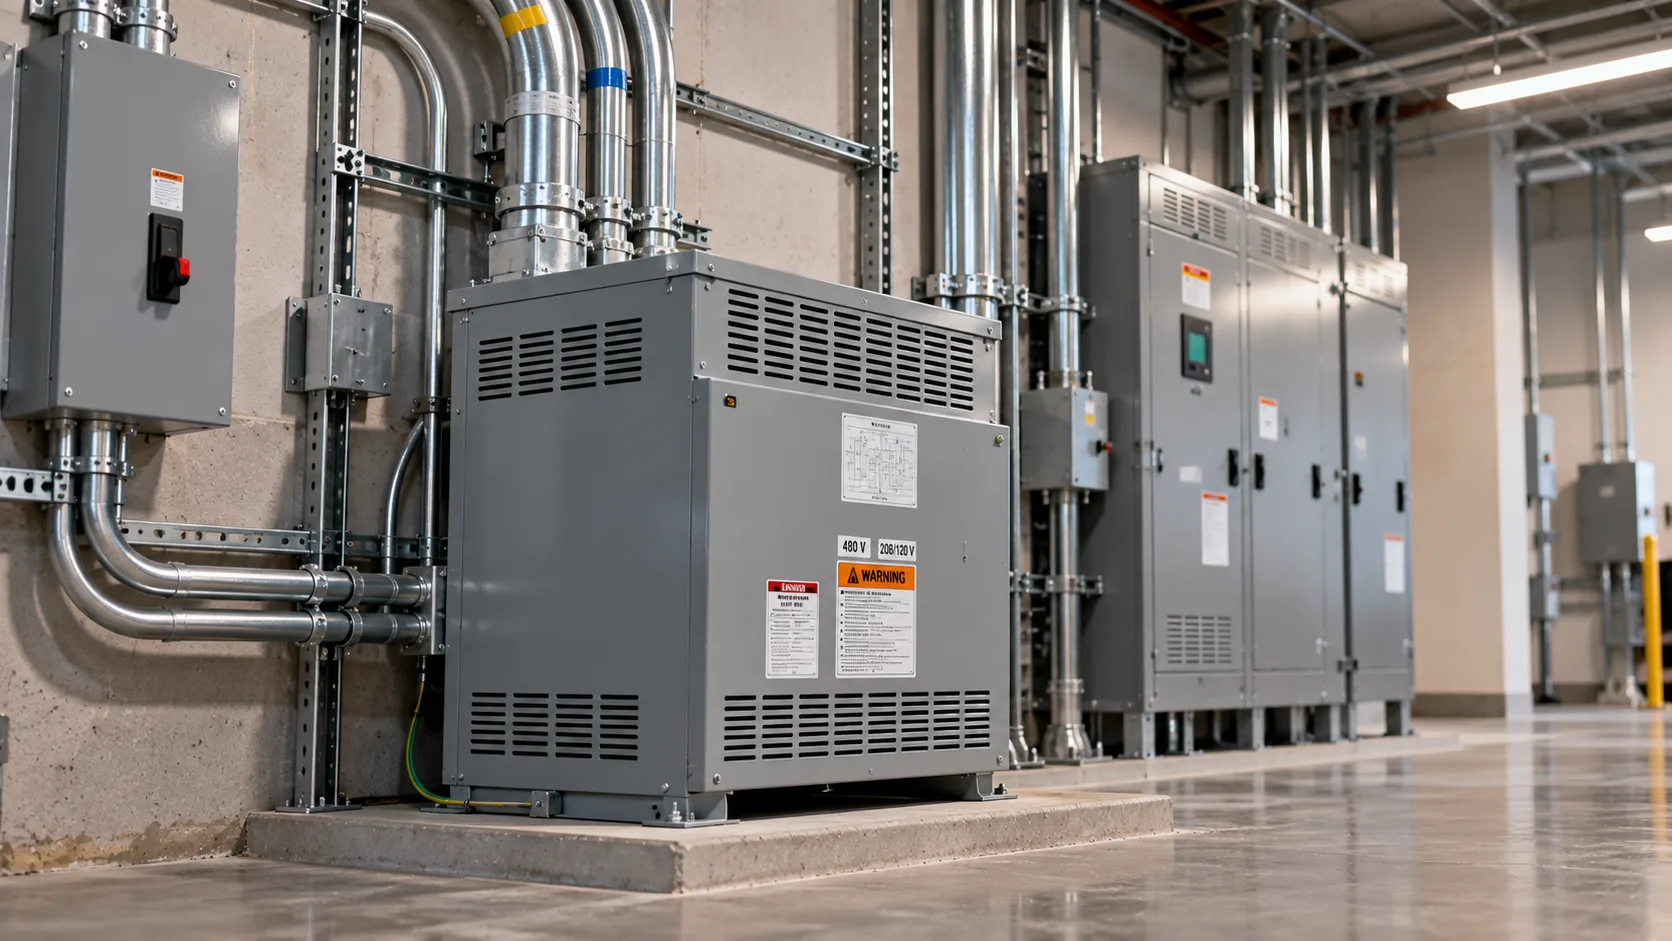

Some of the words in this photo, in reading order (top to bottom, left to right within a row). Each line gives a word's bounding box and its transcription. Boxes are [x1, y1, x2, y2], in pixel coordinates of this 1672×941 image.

[843, 540, 858, 553] 480
[860, 541, 866, 553] V
[880, 543, 908, 556] 208/120
[909, 545, 915, 556] V
[861, 569, 906, 584] WARNING
